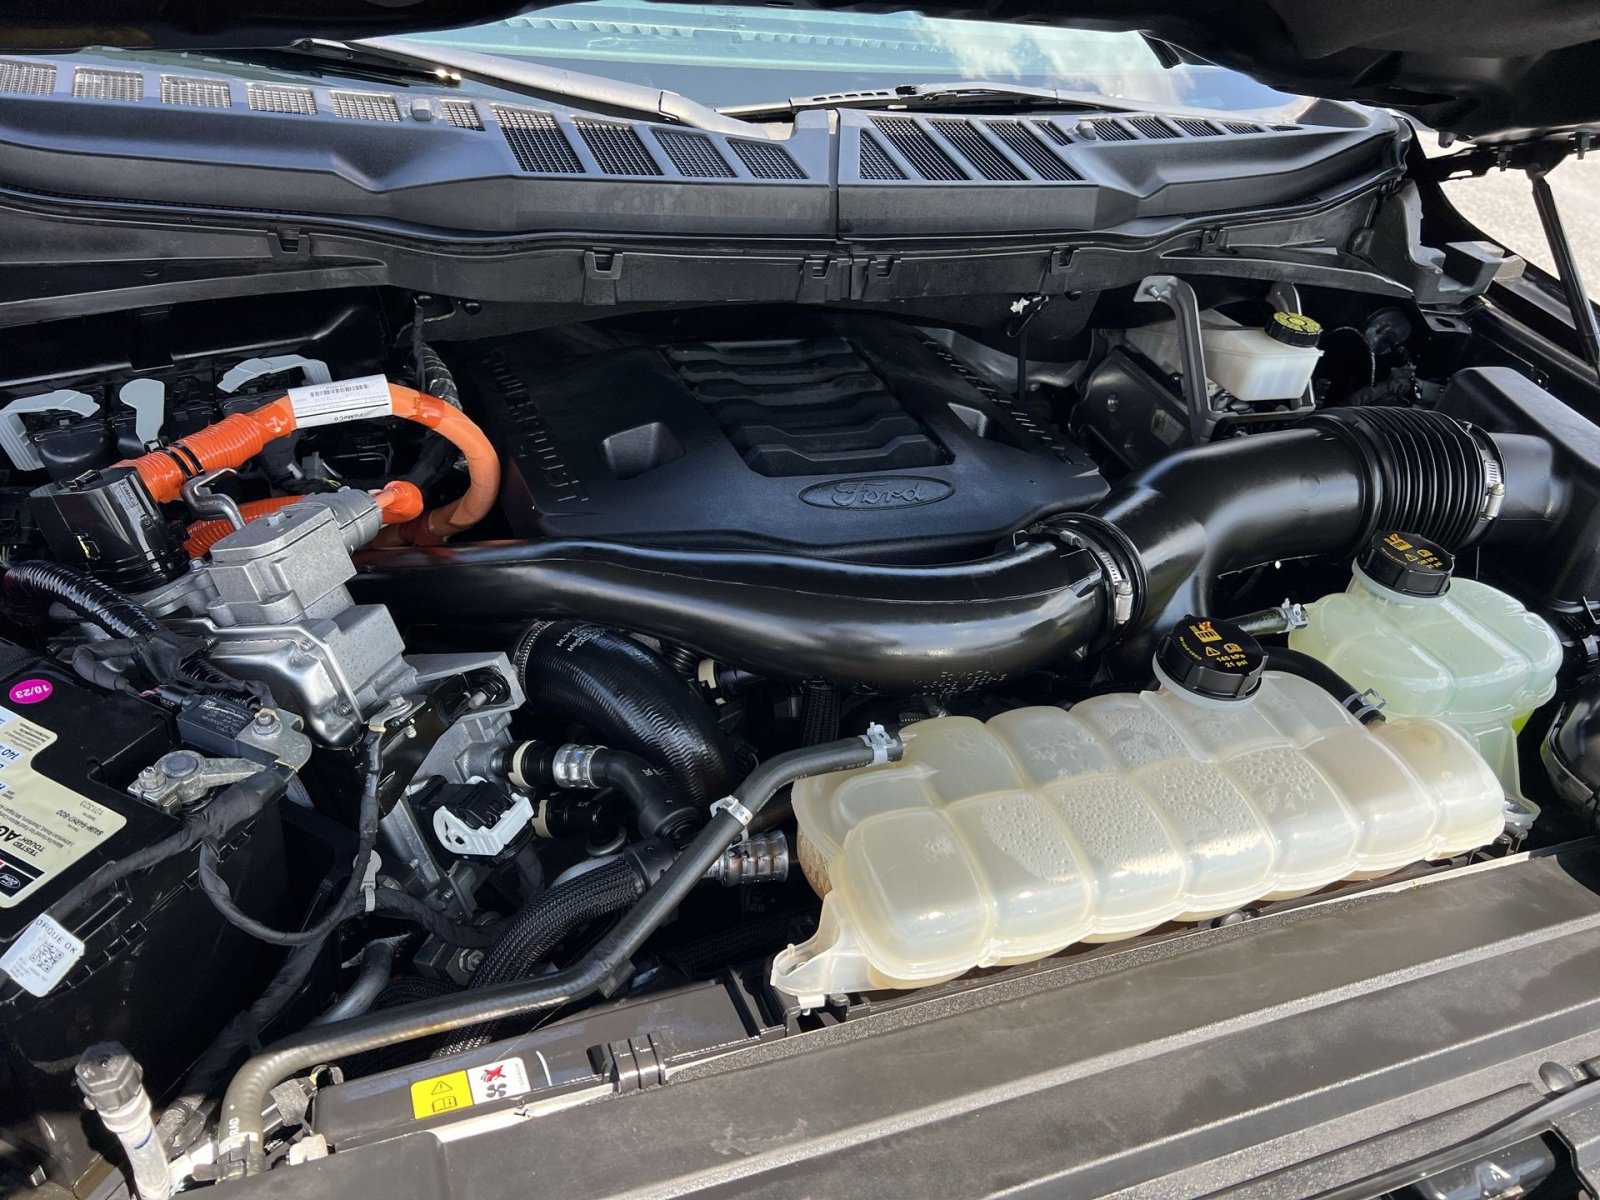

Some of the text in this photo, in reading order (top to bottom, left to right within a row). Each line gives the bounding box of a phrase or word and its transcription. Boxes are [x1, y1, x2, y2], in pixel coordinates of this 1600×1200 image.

[832, 482, 927, 506] Ford
[1236, 659, 1248, 667] psi
[15, 684, 50, 699] 10/23
[12, 840, 38, 857] TESTED
[35, 920, 79, 954] ORQUE OK
